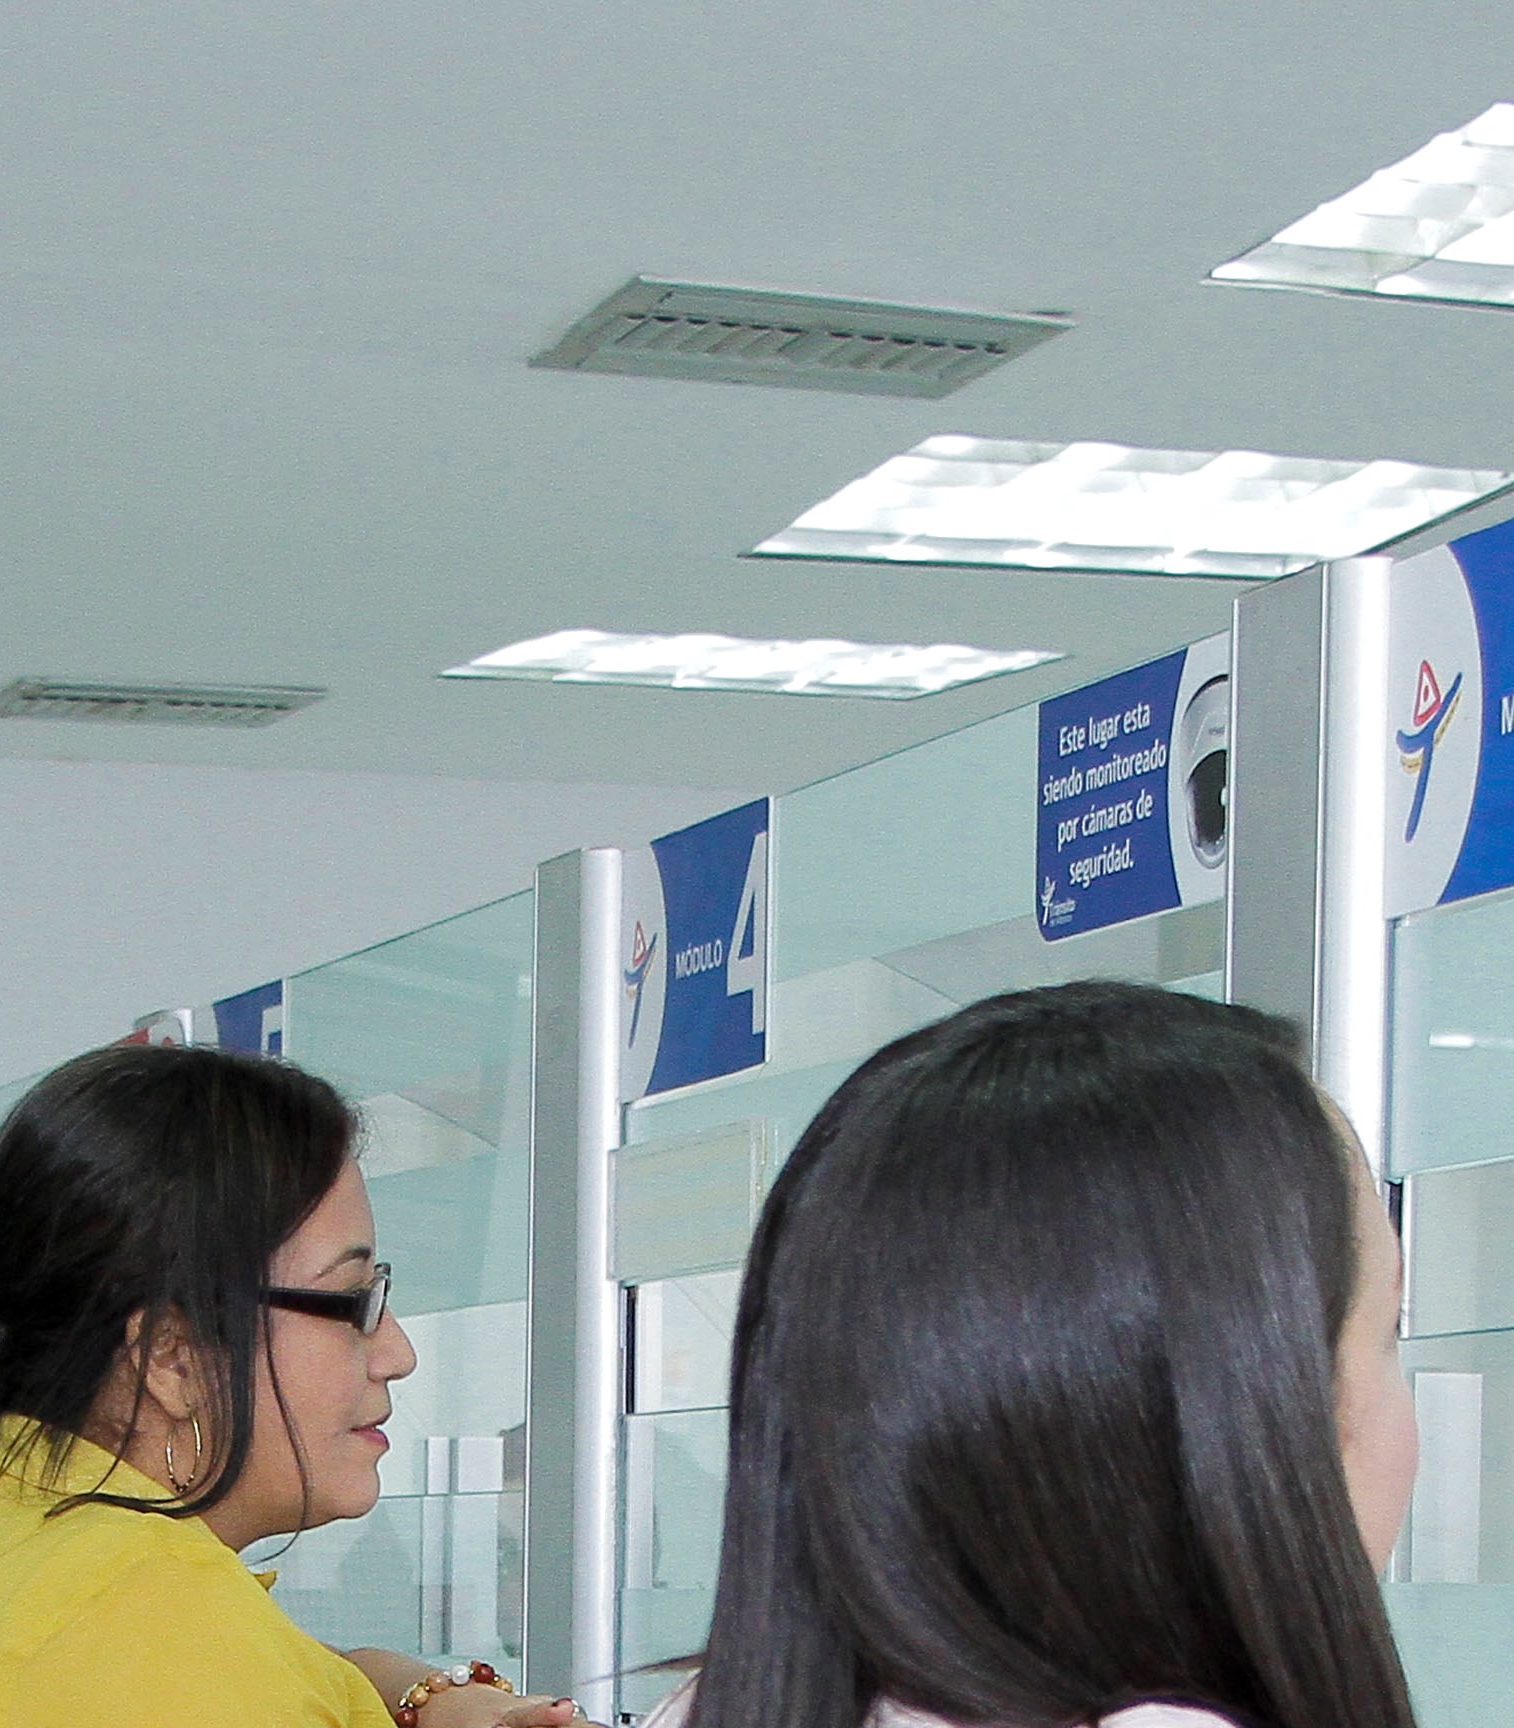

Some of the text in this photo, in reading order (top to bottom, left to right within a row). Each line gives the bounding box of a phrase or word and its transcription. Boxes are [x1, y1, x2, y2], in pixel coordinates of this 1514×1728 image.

[1059, 702, 1151, 757] Este lugar esta
[1043, 738, 1167, 806] siendo monitoreado
[1057, 788, 1154, 853] por cámaras de
[1069, 838, 1134, 888] seguridad.
[675, 831, 767, 1035] MÓDULO 4
